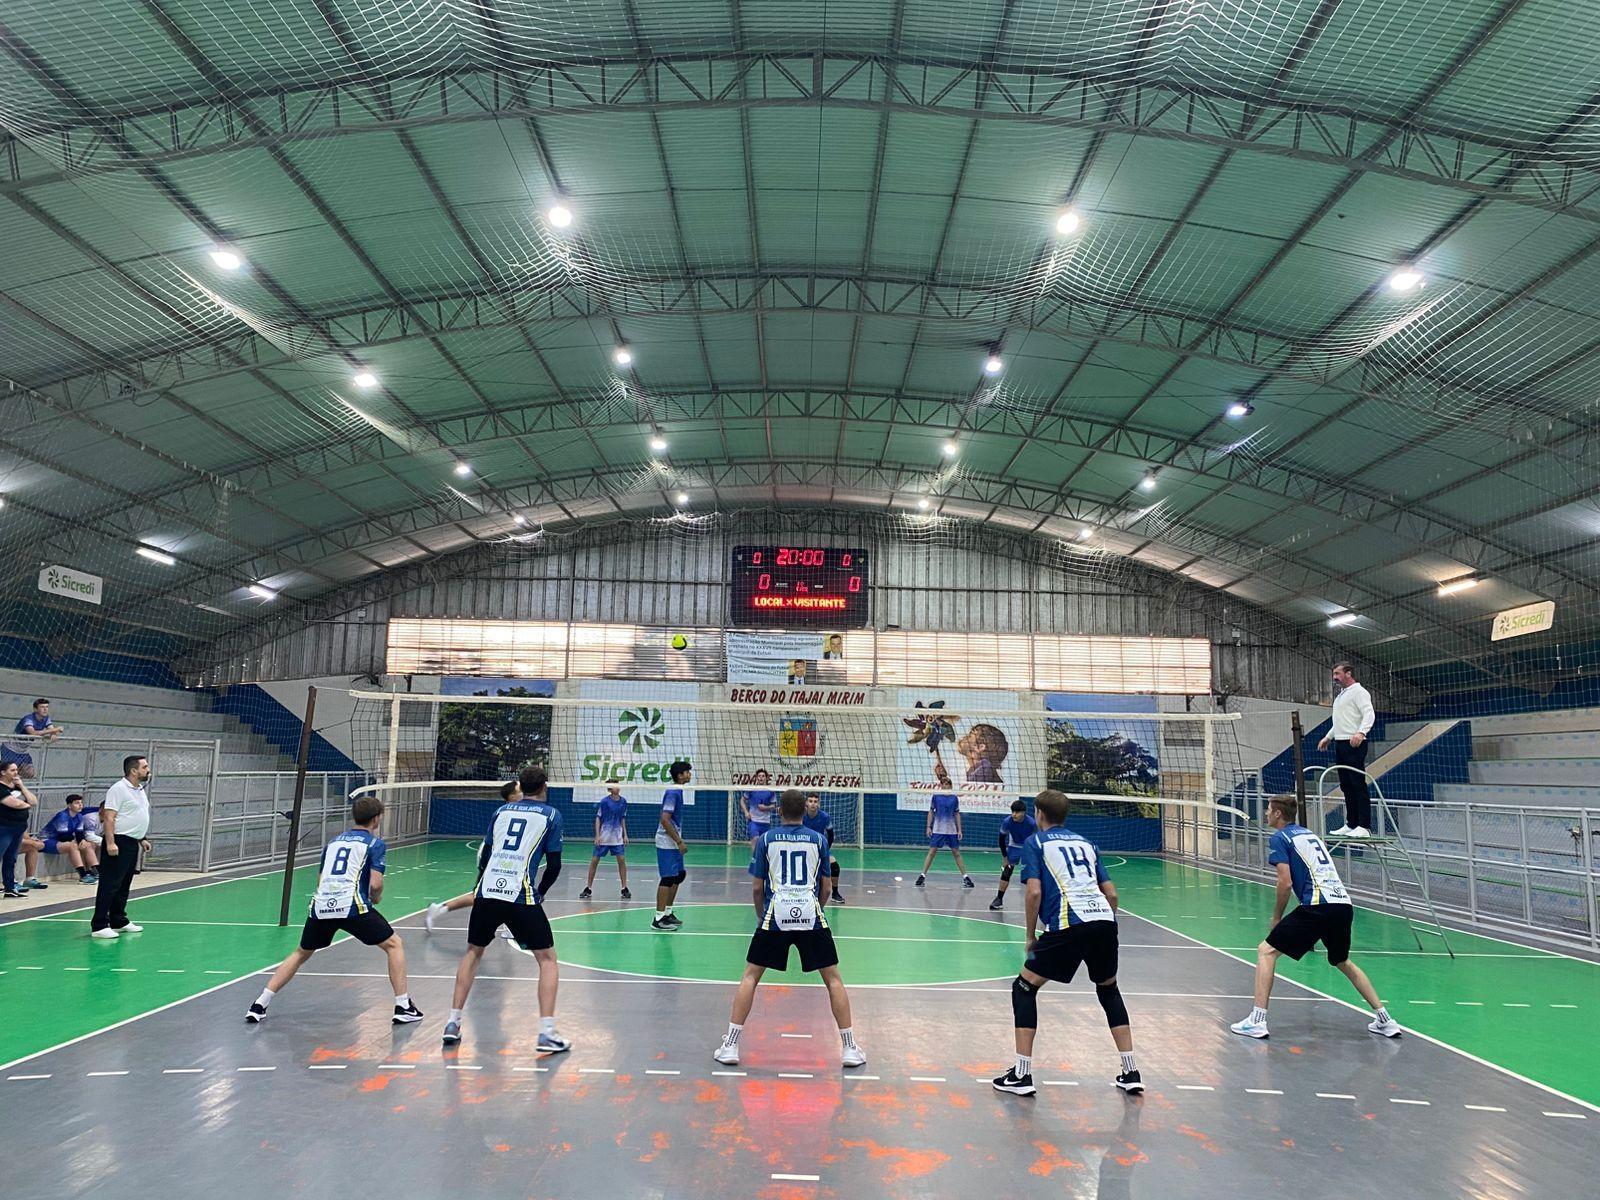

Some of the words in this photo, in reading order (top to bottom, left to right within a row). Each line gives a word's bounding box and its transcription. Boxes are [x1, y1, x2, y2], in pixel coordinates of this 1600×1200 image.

[753, 552, 761, 564] 0
[777, 549, 824, 566] 20:00
[843, 554, 852, 566] 0
[61, 575, 95, 595] Sicredi
[759, 574, 770, 590] 0
[849, 576, 860, 592] 0
[754, 597, 783, 607] LOCAL
[794, 597, 846, 608] VISITANTE
[1510, 609, 1546, 629] Sicredi
[770, 690, 786, 704] DO
[827, 691, 866, 705] MIRIM
[732, 773, 773, 786] CIDAE
[776, 774, 791, 787] DA
[794, 774, 825, 787] DOCE
[828, 775, 861, 788] FESTA
[503, 818, 527, 851] 9
[1307, 839, 1329, 864] 3
[331, 847, 351, 875] 8
[780, 850, 808, 886] 10
[1058, 846, 1093, 878] 14
